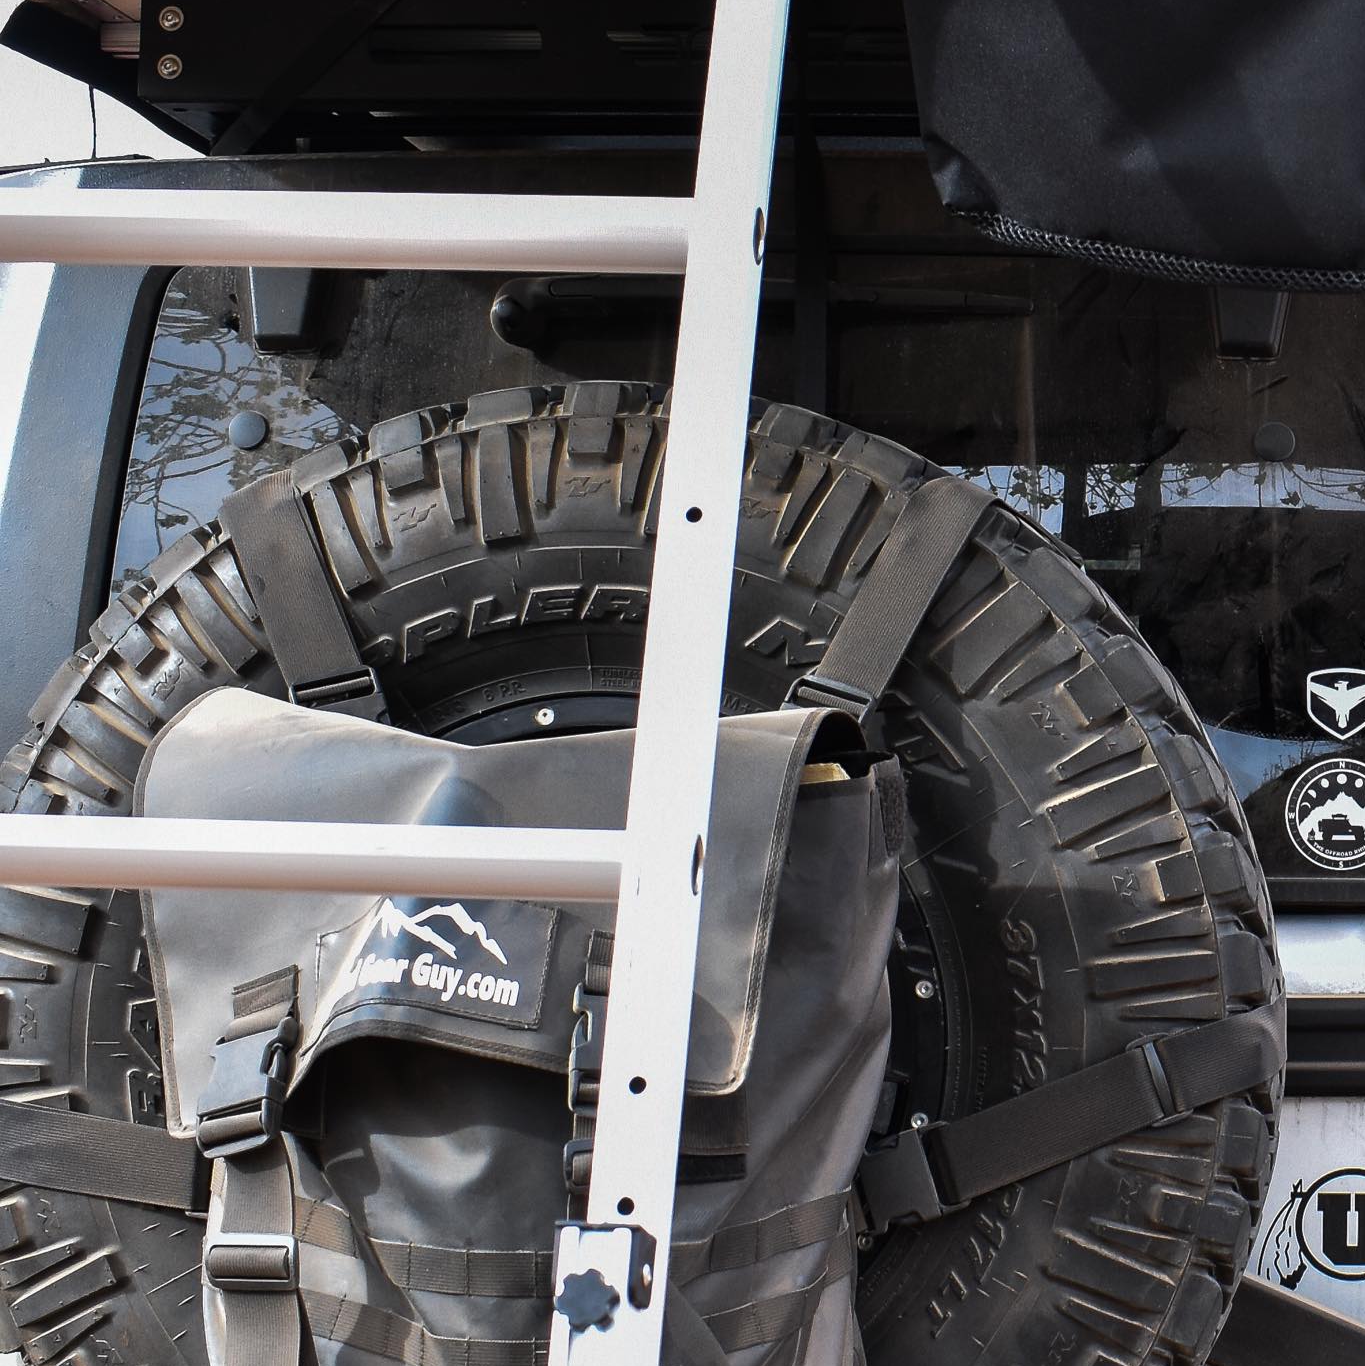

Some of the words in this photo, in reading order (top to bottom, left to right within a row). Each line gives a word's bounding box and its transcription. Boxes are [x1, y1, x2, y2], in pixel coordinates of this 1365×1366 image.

[1339, 761, 1346, 769] N
[1288, 812, 1296, 820] W
[1313, 841, 1325, 852] THE
[1325, 849, 1353, 857] OFFROAD
[1338, 860, 1344, 869] S
[411, 952, 520, 1007] Guy.com
